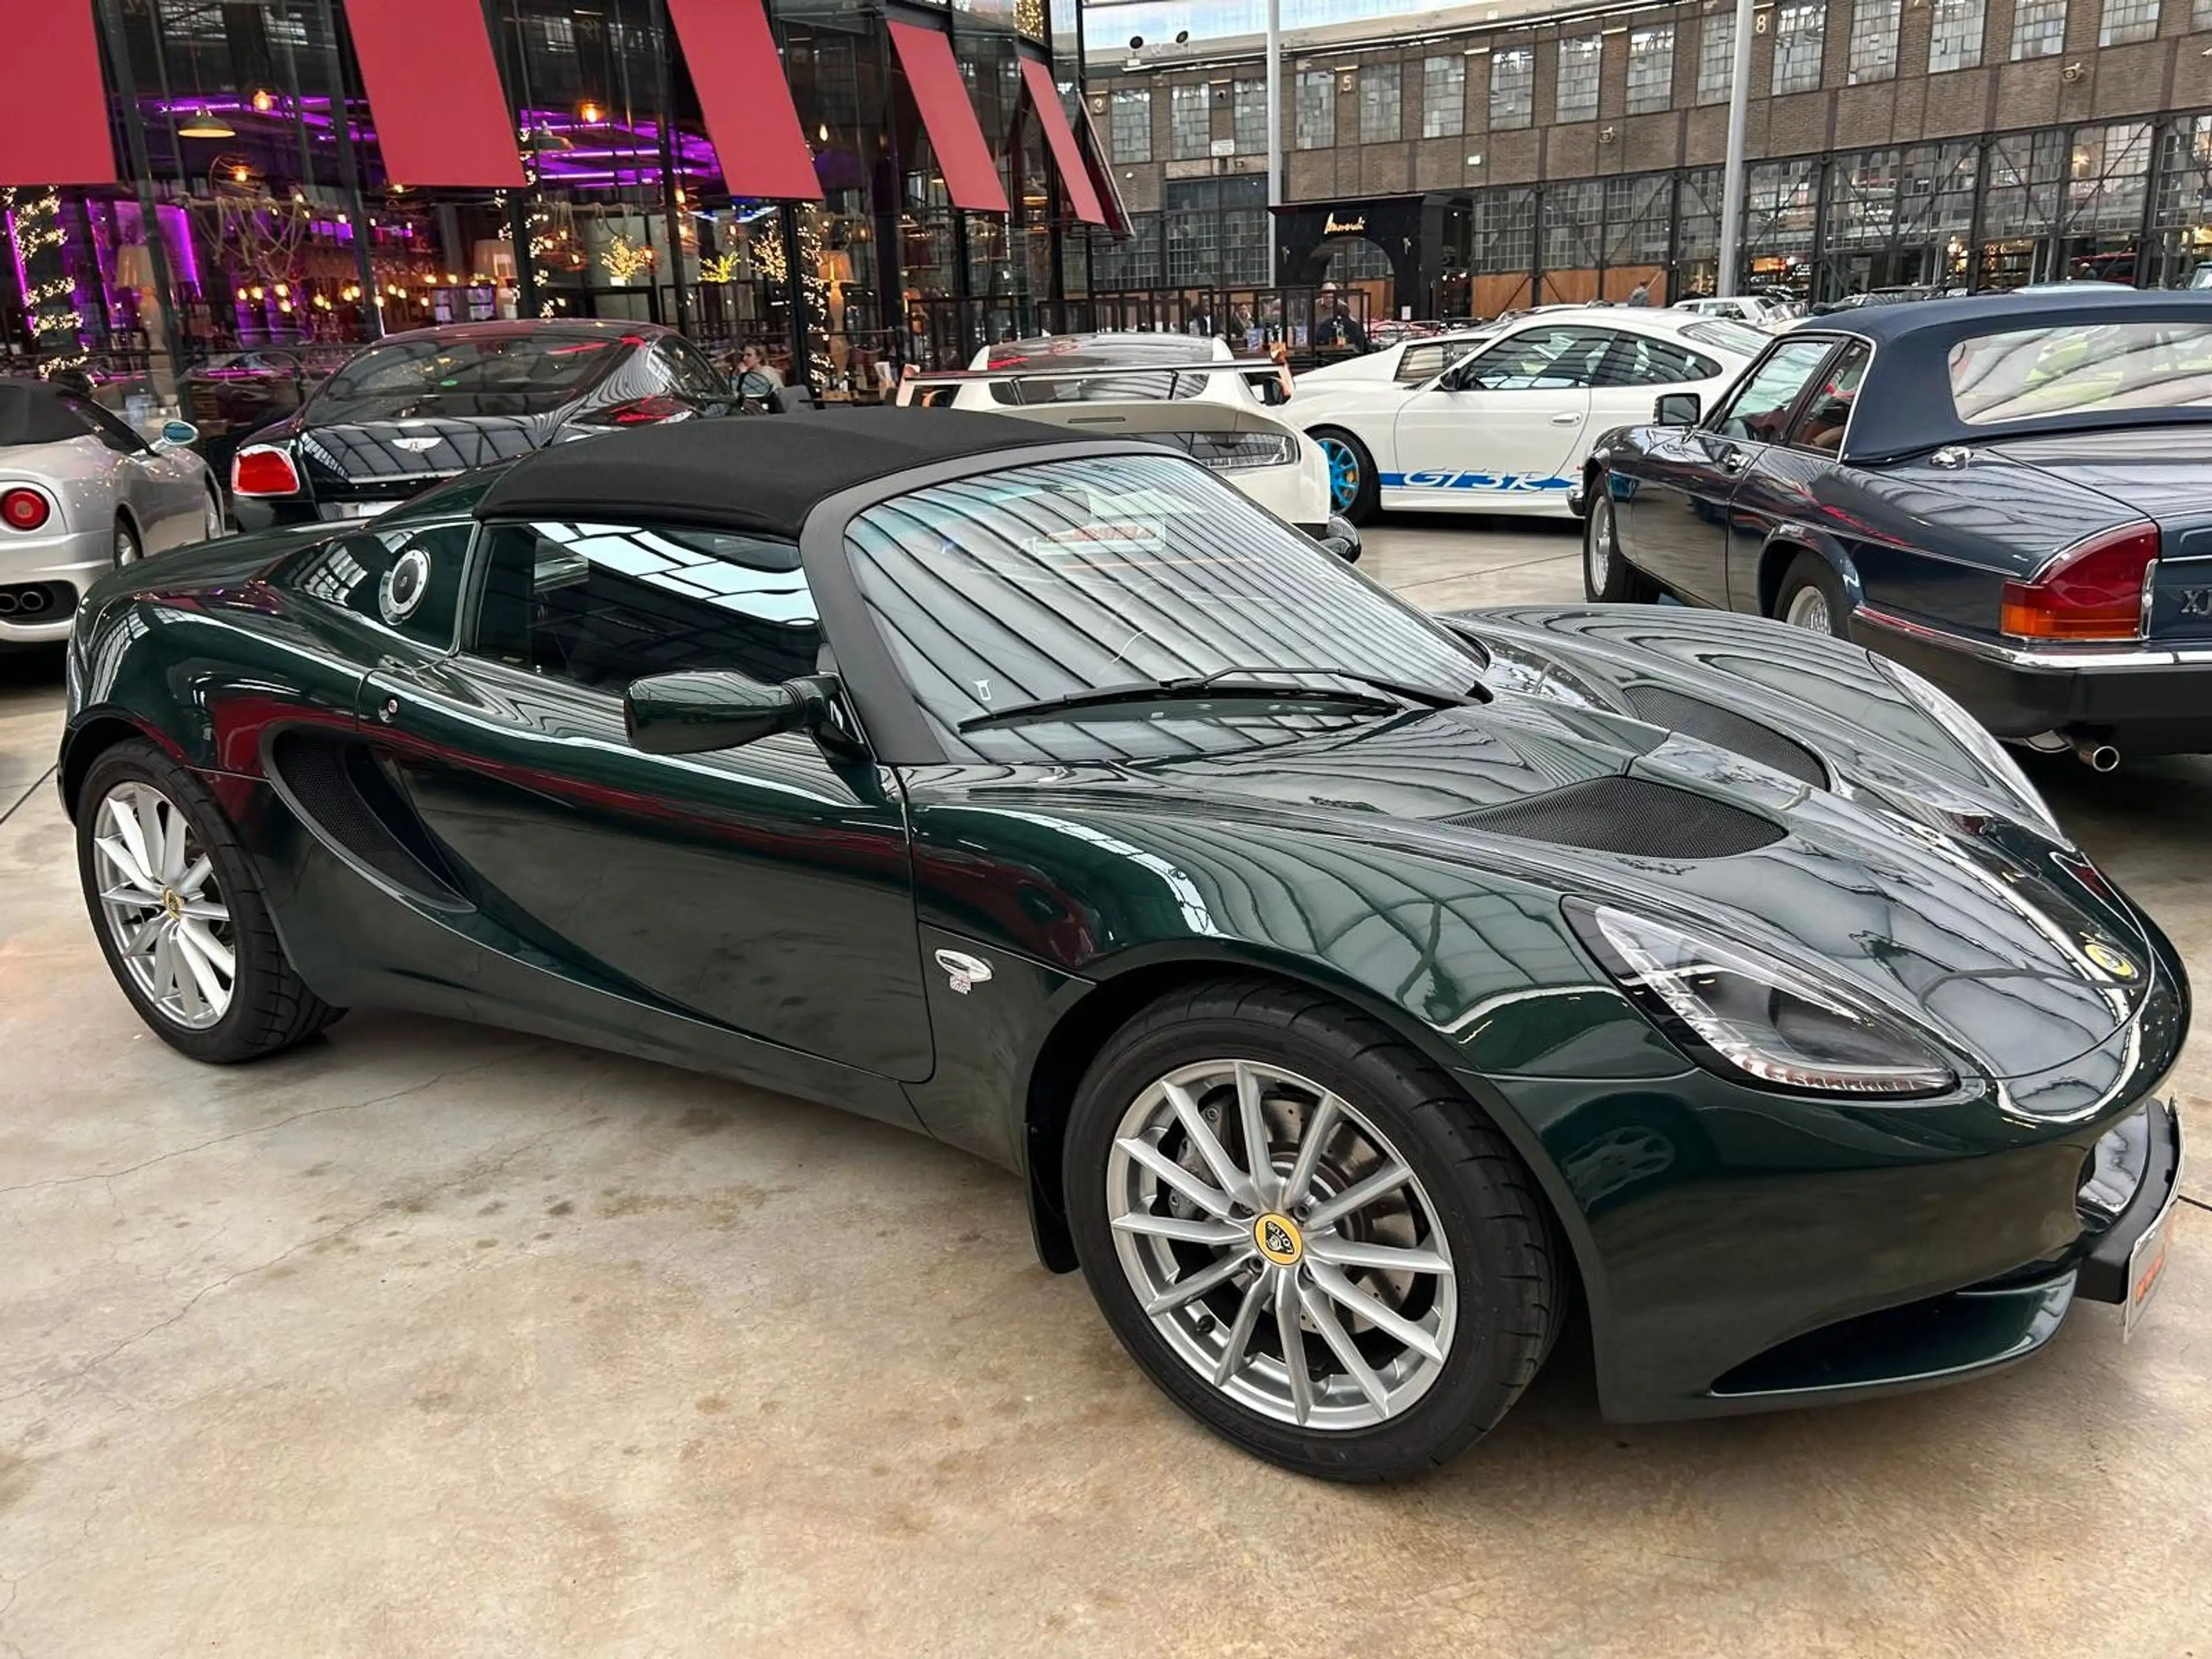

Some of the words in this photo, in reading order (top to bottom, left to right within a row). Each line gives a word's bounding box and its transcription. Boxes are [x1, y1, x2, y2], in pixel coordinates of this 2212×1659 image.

[1756, 14, 1766, 34] 8
[1343, 75, 1352, 91] 5
[1267, 1222, 1294, 1253] LOTUS
